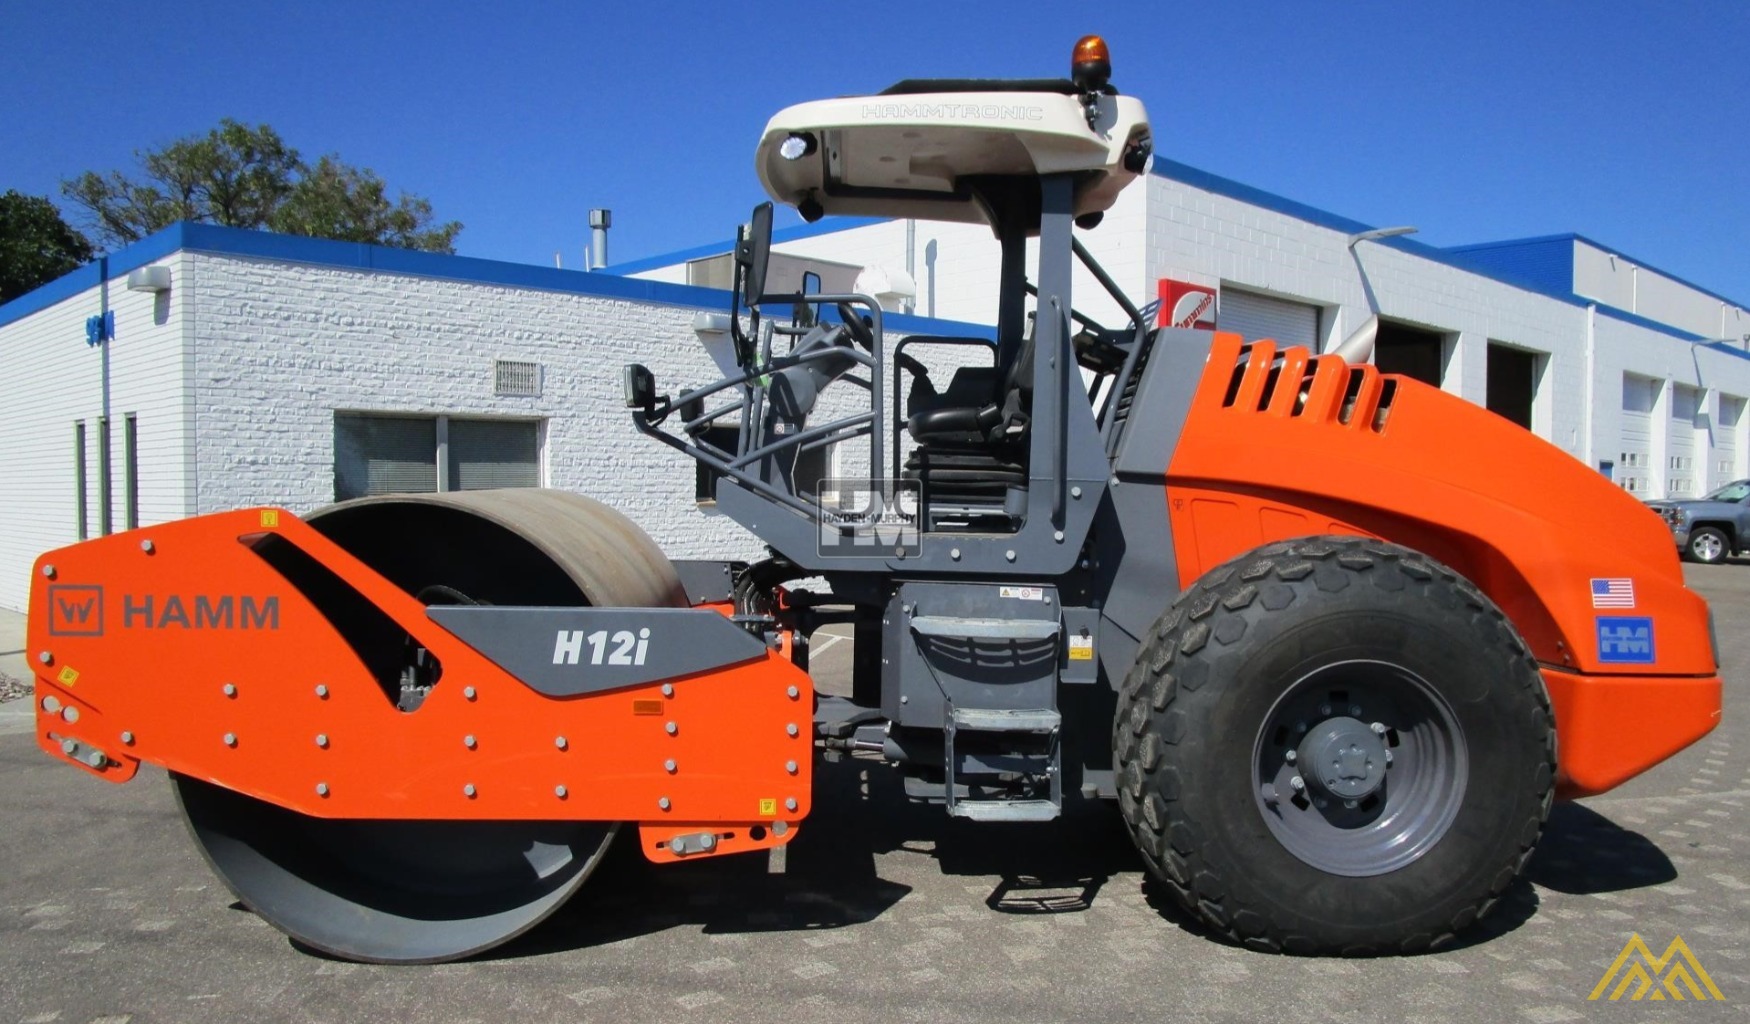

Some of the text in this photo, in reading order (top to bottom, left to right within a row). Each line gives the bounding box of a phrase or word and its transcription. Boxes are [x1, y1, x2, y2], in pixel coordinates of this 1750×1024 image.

[862, 103, 1044, 121] HAMMTRONIC
[123, 594, 280, 630] HAMM
[552, 627, 651, 666] H12i
[1600, 626, 1650, 654] HM
